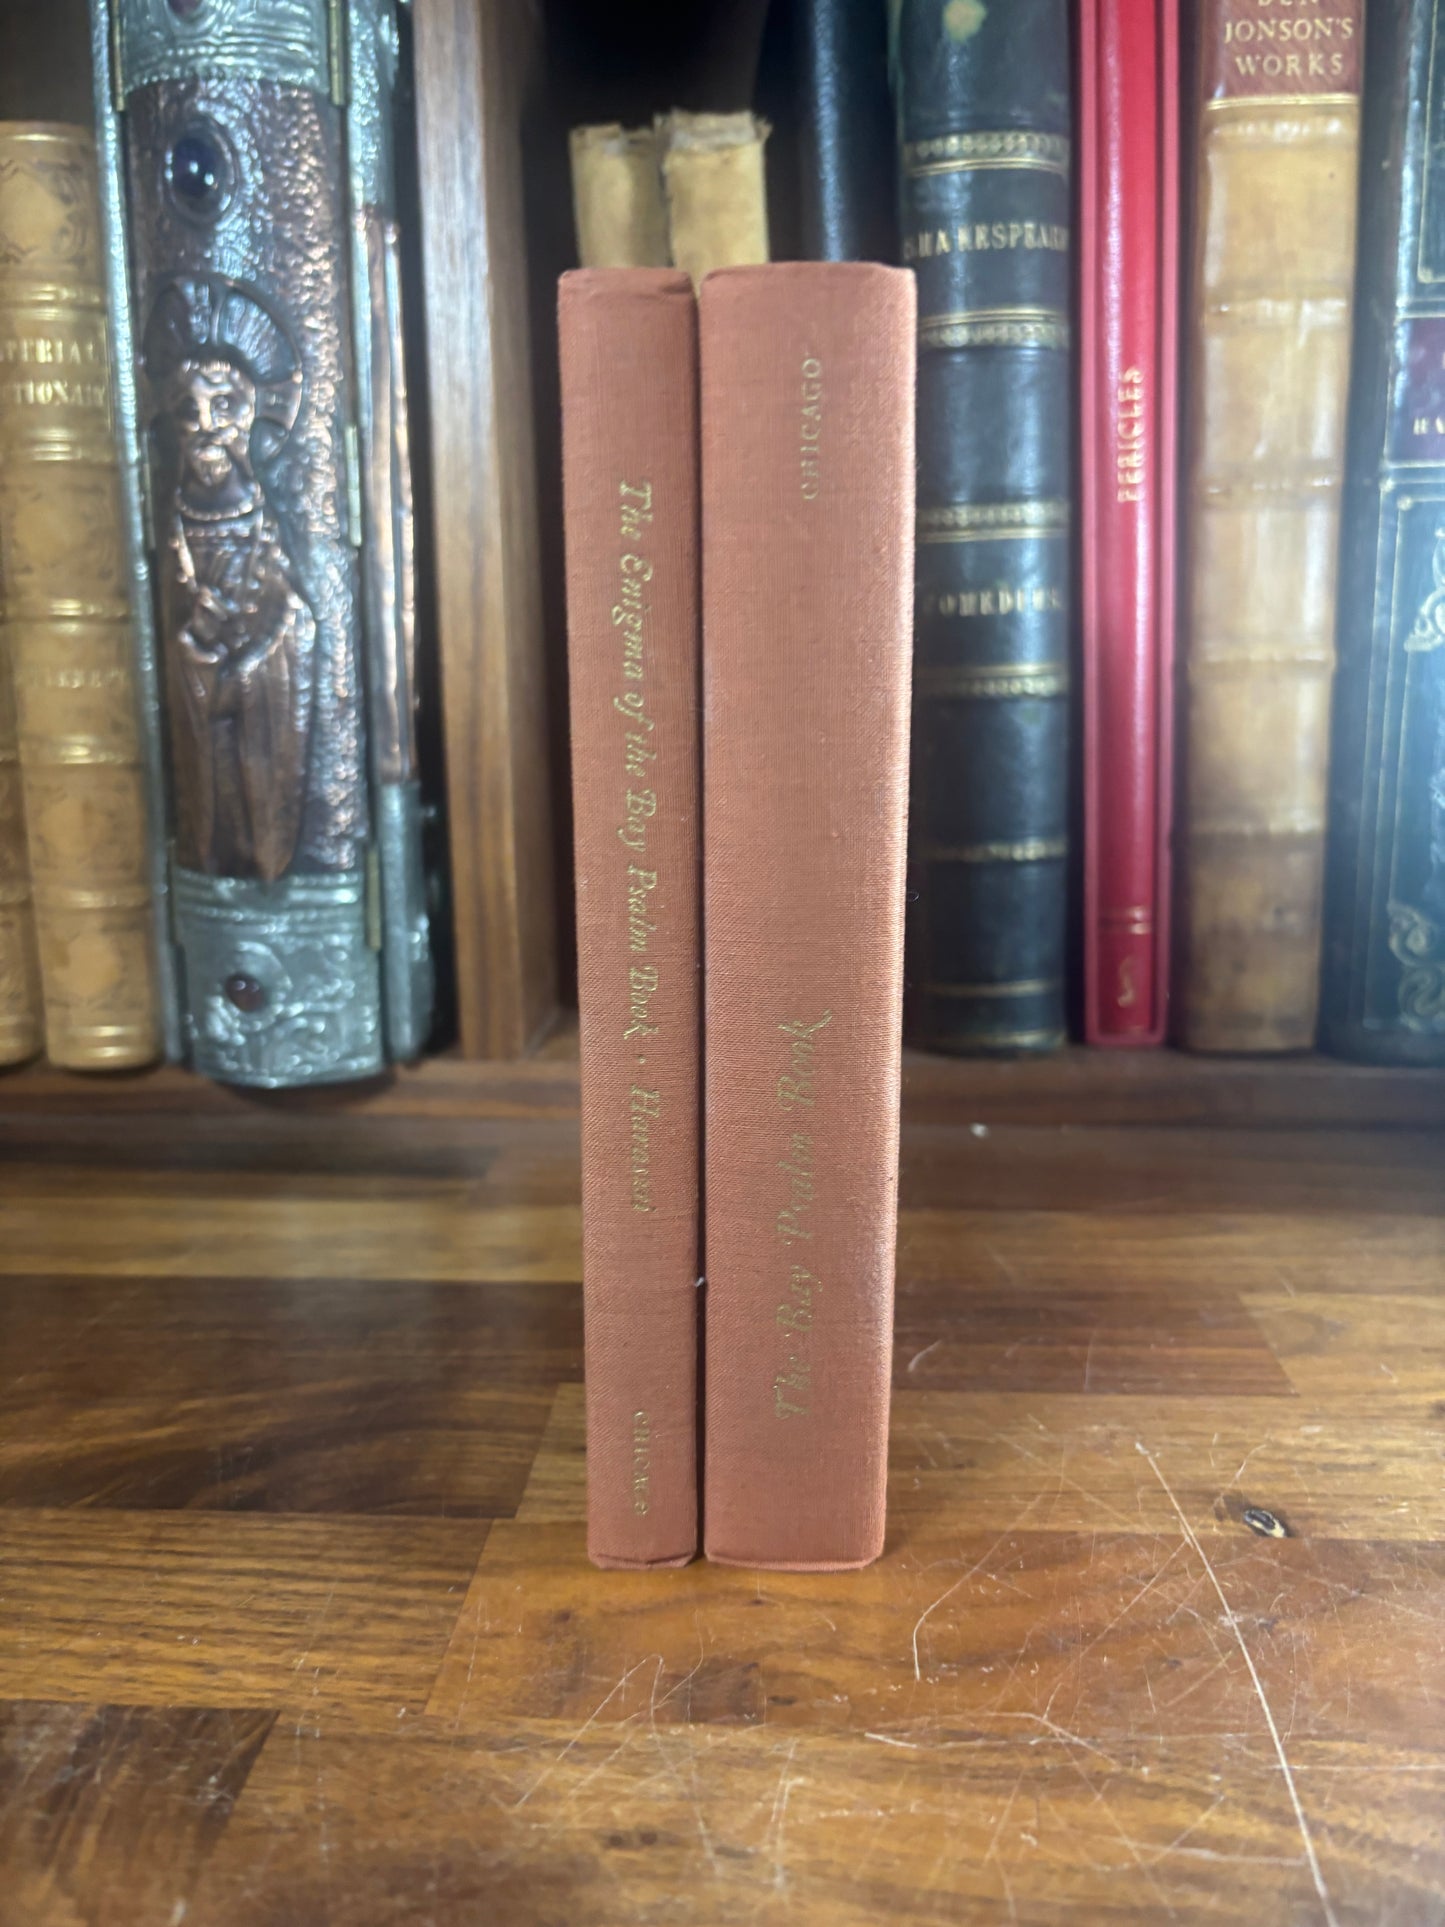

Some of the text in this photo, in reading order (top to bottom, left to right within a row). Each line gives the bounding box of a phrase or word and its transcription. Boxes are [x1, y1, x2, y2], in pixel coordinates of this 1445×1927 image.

[1224, 17, 1354, 44] JONSON'S
[1235, 53, 1343, 76] WORKS
[800, 358, 822, 500] CHICAGO
[1117, 366, 1144, 502] PERICLES
[619, 480, 653, 541] The
[611, 553, 654, 679] Enigma
[613, 692, 655, 731] of
[625, 731, 657, 777] the
[617, 788, 657, 853] Bay
[627, 863, 657, 952] Psalm
[623, 965, 659, 1040] Book
[773, 1009, 833, 1420] The Bay Psalm Book
